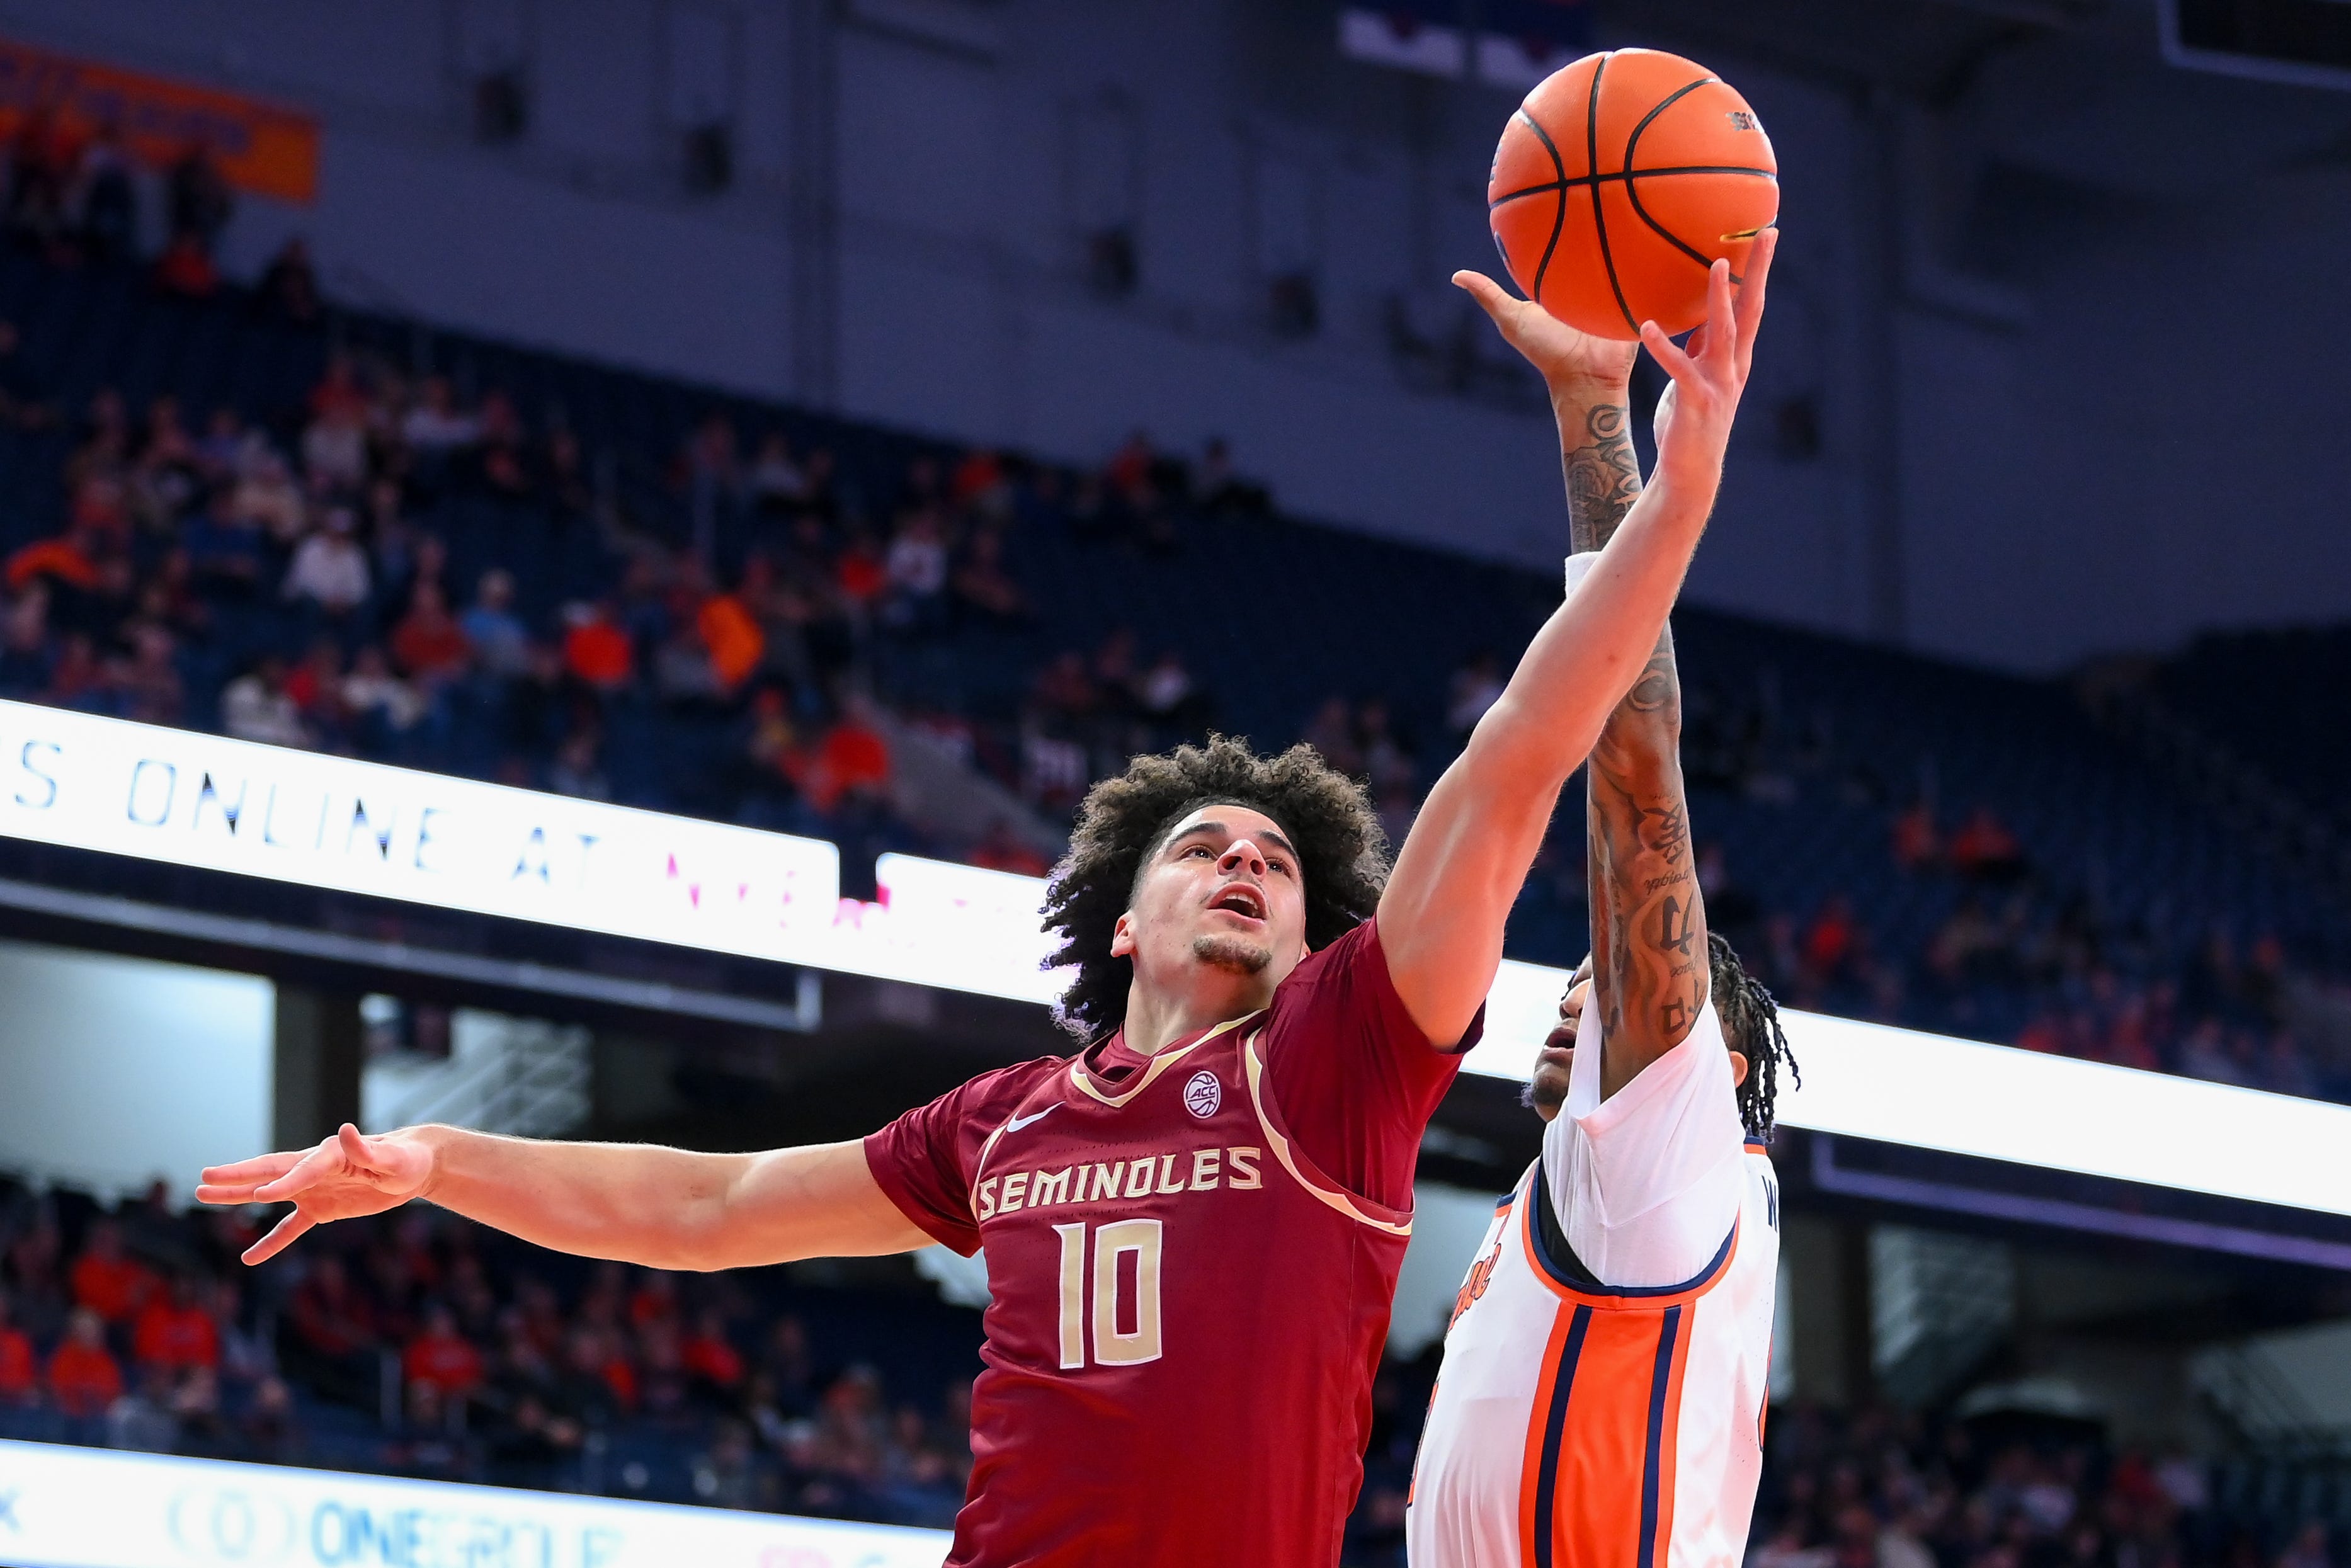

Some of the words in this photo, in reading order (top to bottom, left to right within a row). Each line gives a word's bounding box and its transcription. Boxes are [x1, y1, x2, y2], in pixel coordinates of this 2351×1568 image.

[127, 759, 448, 872] ONLINE
[511, 826, 600, 889] AT
[1190, 1084, 1217, 1099] ACC
[979, 1146, 1263, 1223] SEMINOLES
[1051, 1218, 1163, 1370] 10
